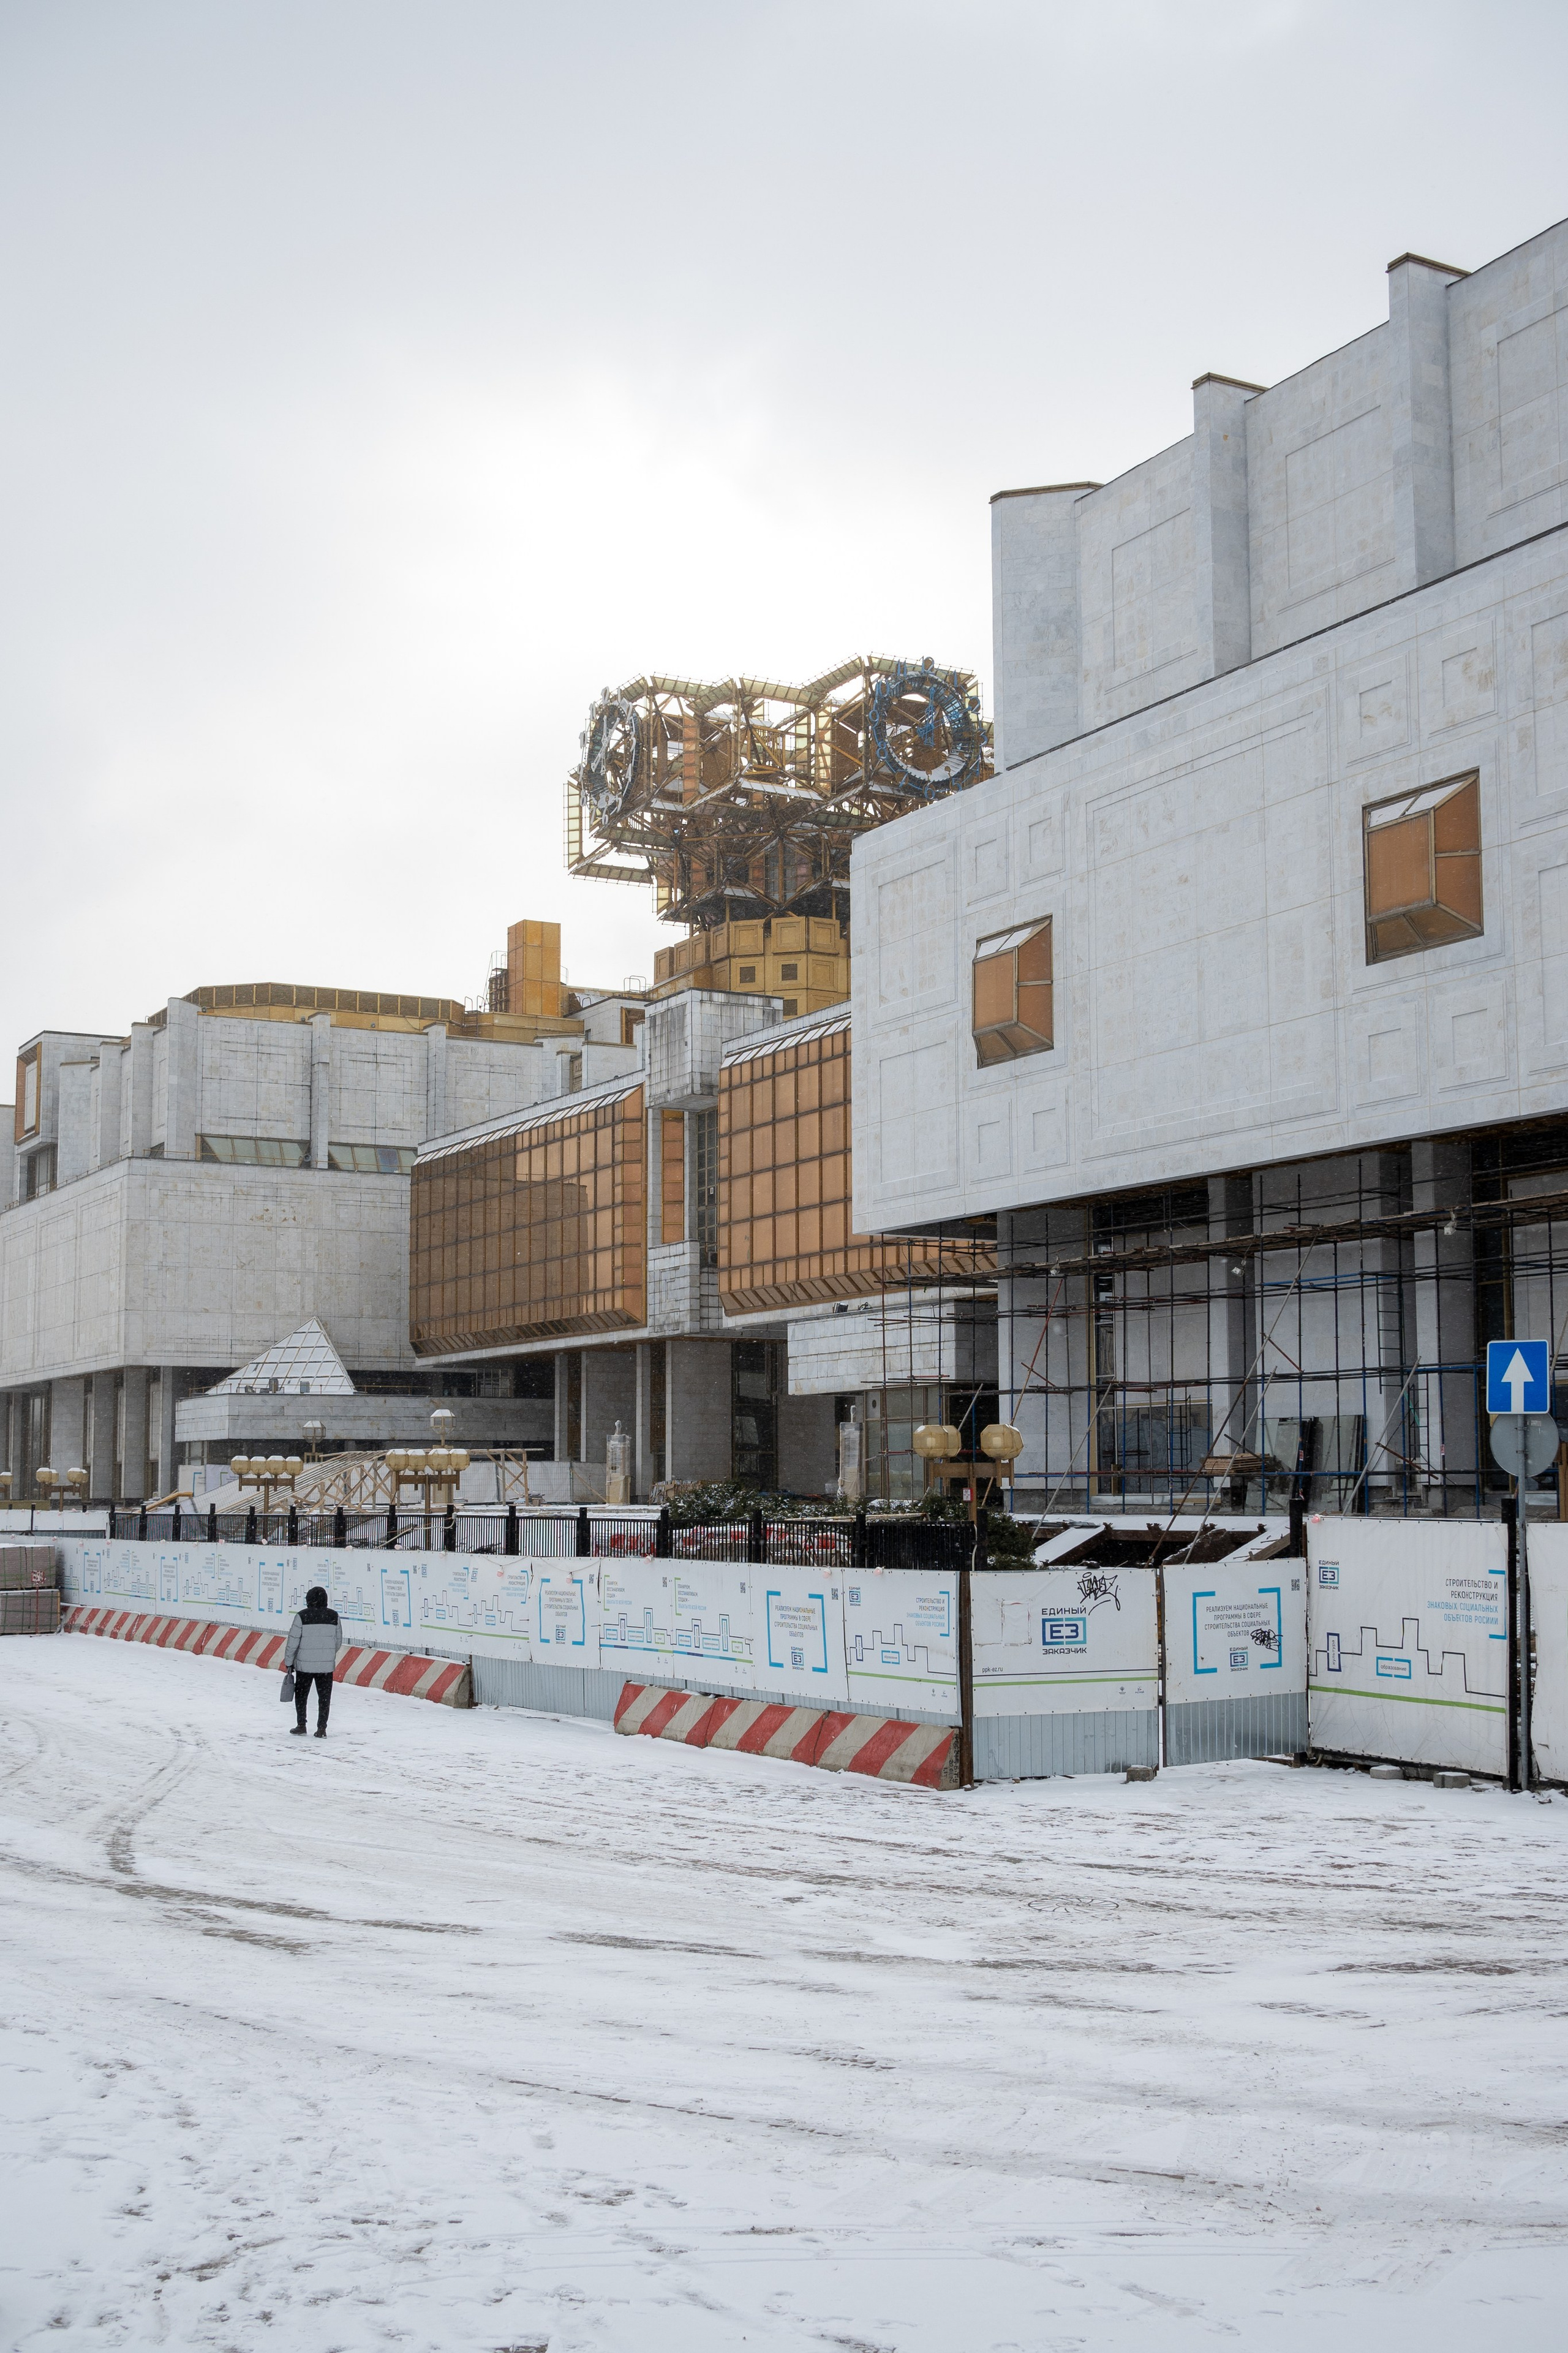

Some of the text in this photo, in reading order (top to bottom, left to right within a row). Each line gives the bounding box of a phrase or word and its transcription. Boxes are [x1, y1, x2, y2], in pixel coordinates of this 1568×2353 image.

[919, 655, 934, 673] 12
[869, 709, 879, 729] 9
[876, 741, 888, 759] 8
[924, 781, 935, 799] 6
[1446, 1579, 1491, 1588] СТРОИТЕЛЬСТВО
[1451, 1591, 1498, 1601] РЕКОНСТРУКЦИЯ
[1042, 1607, 1086, 1615] ЕДИНЫЙ
[1234, 1603, 1268, 1611] НАЦИОНАЛЬНЫЕ
[1427, 1601, 1498, 1613] ЗНАКОВЫХ СОЦИАЛЬНЫХ
[1444, 1613, 1472, 1623] ОБЪЕКТОВ
